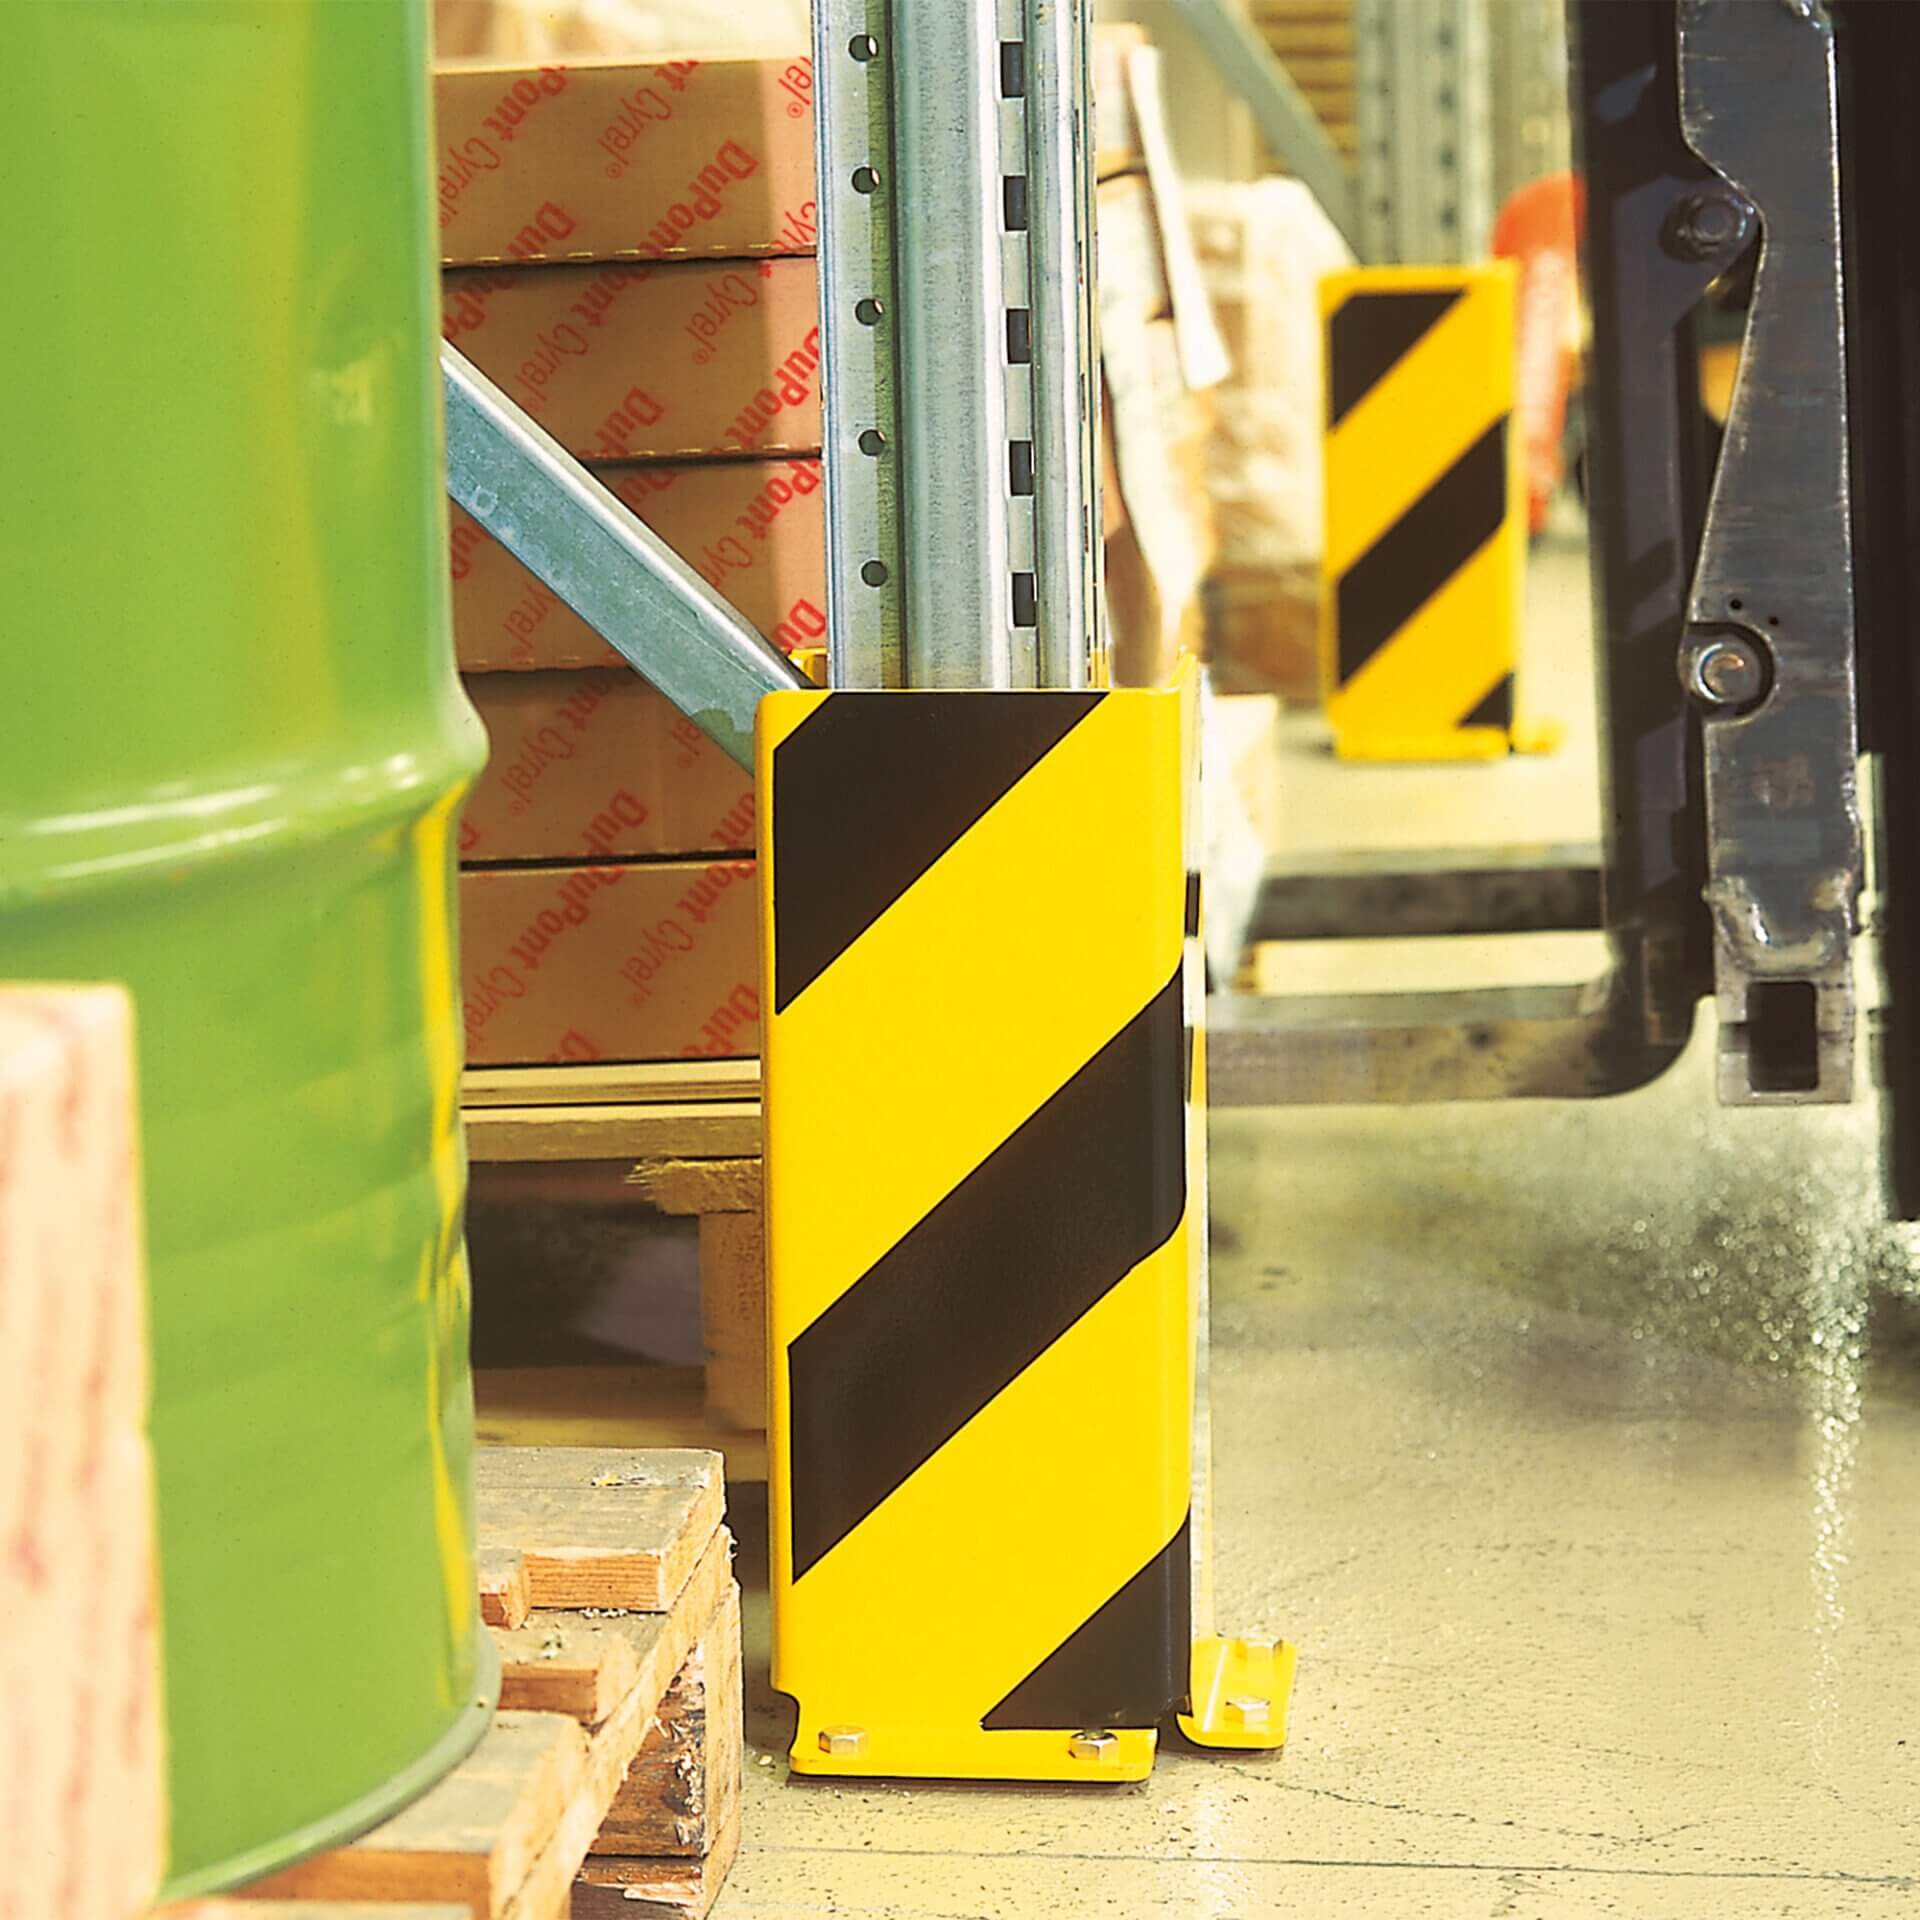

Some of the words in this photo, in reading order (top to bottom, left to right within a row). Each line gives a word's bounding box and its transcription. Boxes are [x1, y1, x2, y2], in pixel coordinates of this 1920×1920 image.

[482, 65, 567, 141] Pont
[737, 458, 822, 540] Pont
[702, 536, 752, 586] Cyr
